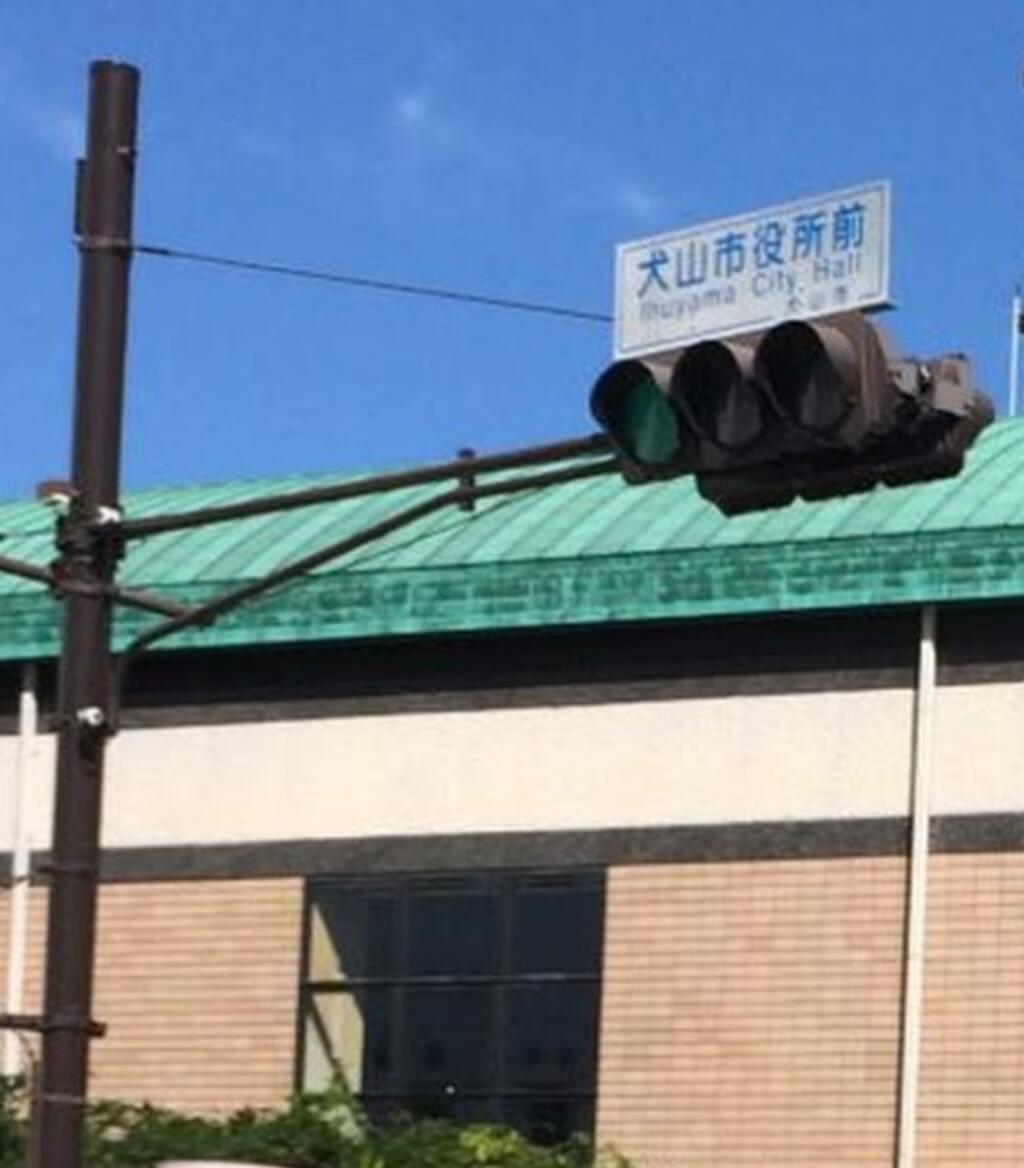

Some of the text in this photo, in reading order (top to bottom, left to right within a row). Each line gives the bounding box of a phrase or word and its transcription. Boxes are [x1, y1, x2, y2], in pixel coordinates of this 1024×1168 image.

[637, 202, 867, 299] 犬山市役所前
[640, 252, 861, 322] Inuyama City Hall
